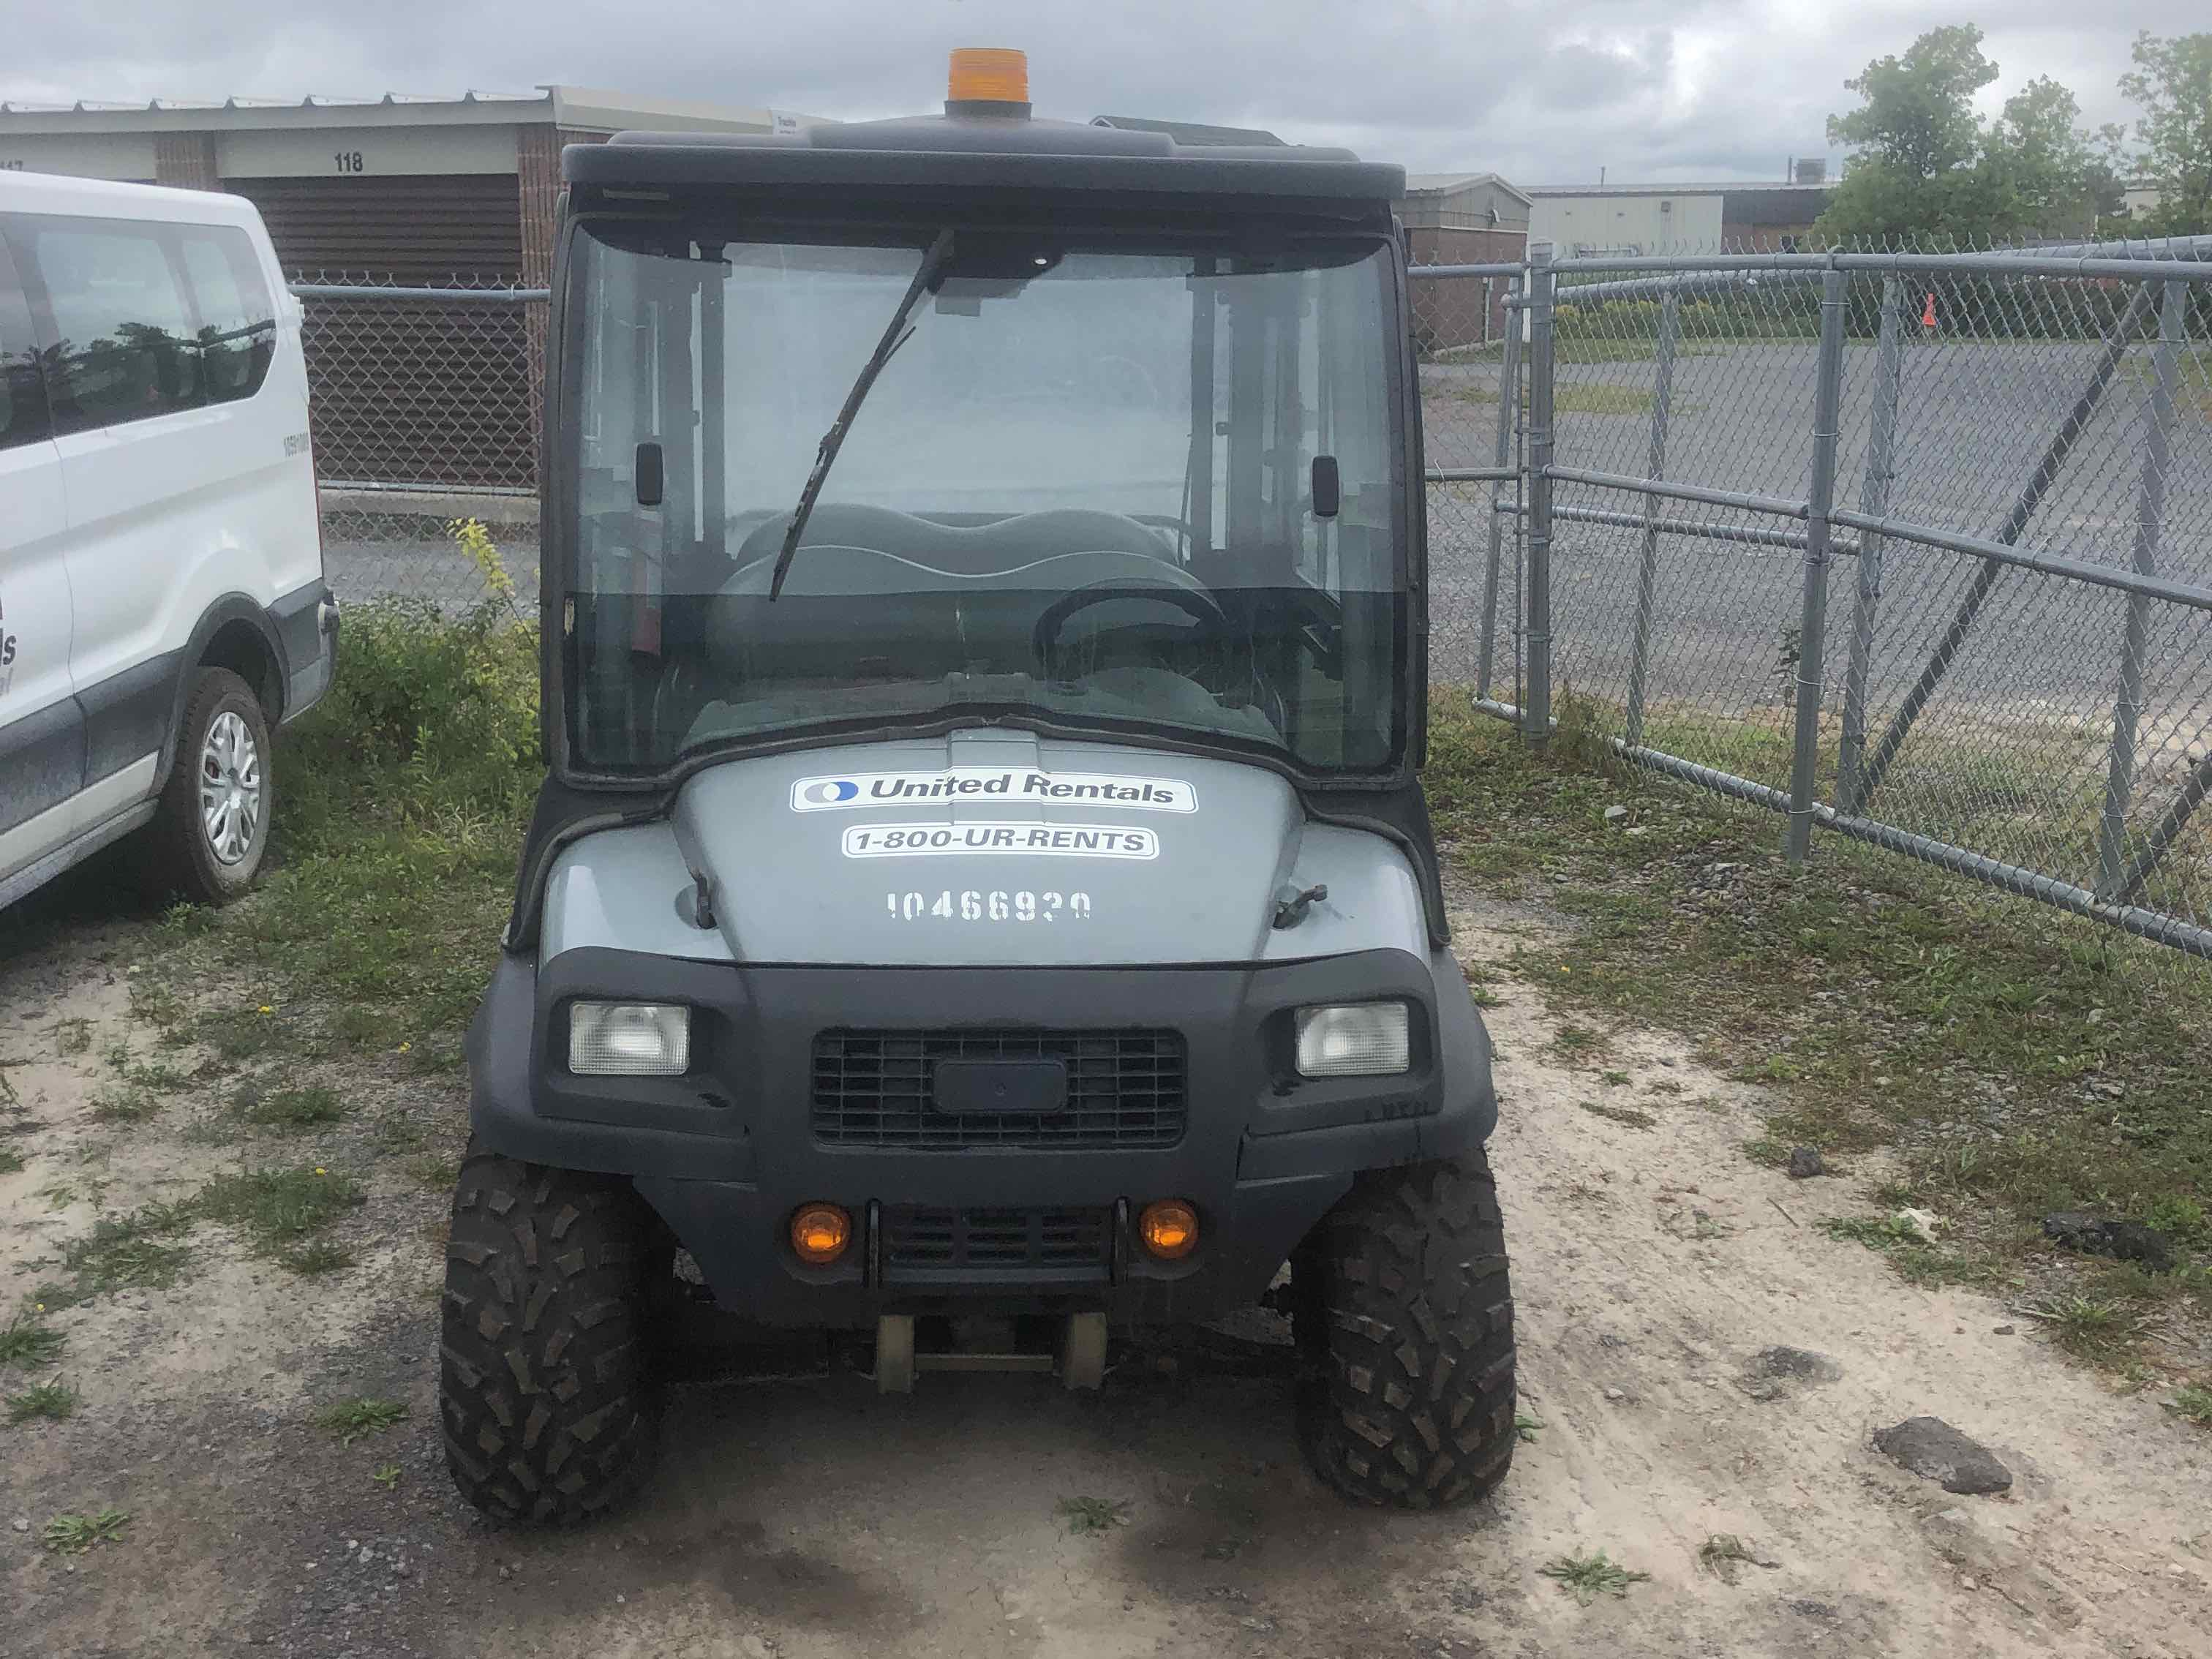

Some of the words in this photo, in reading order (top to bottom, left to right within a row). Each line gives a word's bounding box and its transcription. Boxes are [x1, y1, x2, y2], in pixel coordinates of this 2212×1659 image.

[334, 151, 363, 172] 118
[870, 774, 1012, 798] United
[1023, 774, 1173, 803] Rentals
[856, 828, 1145, 851] 1-800-UR-RENTS
